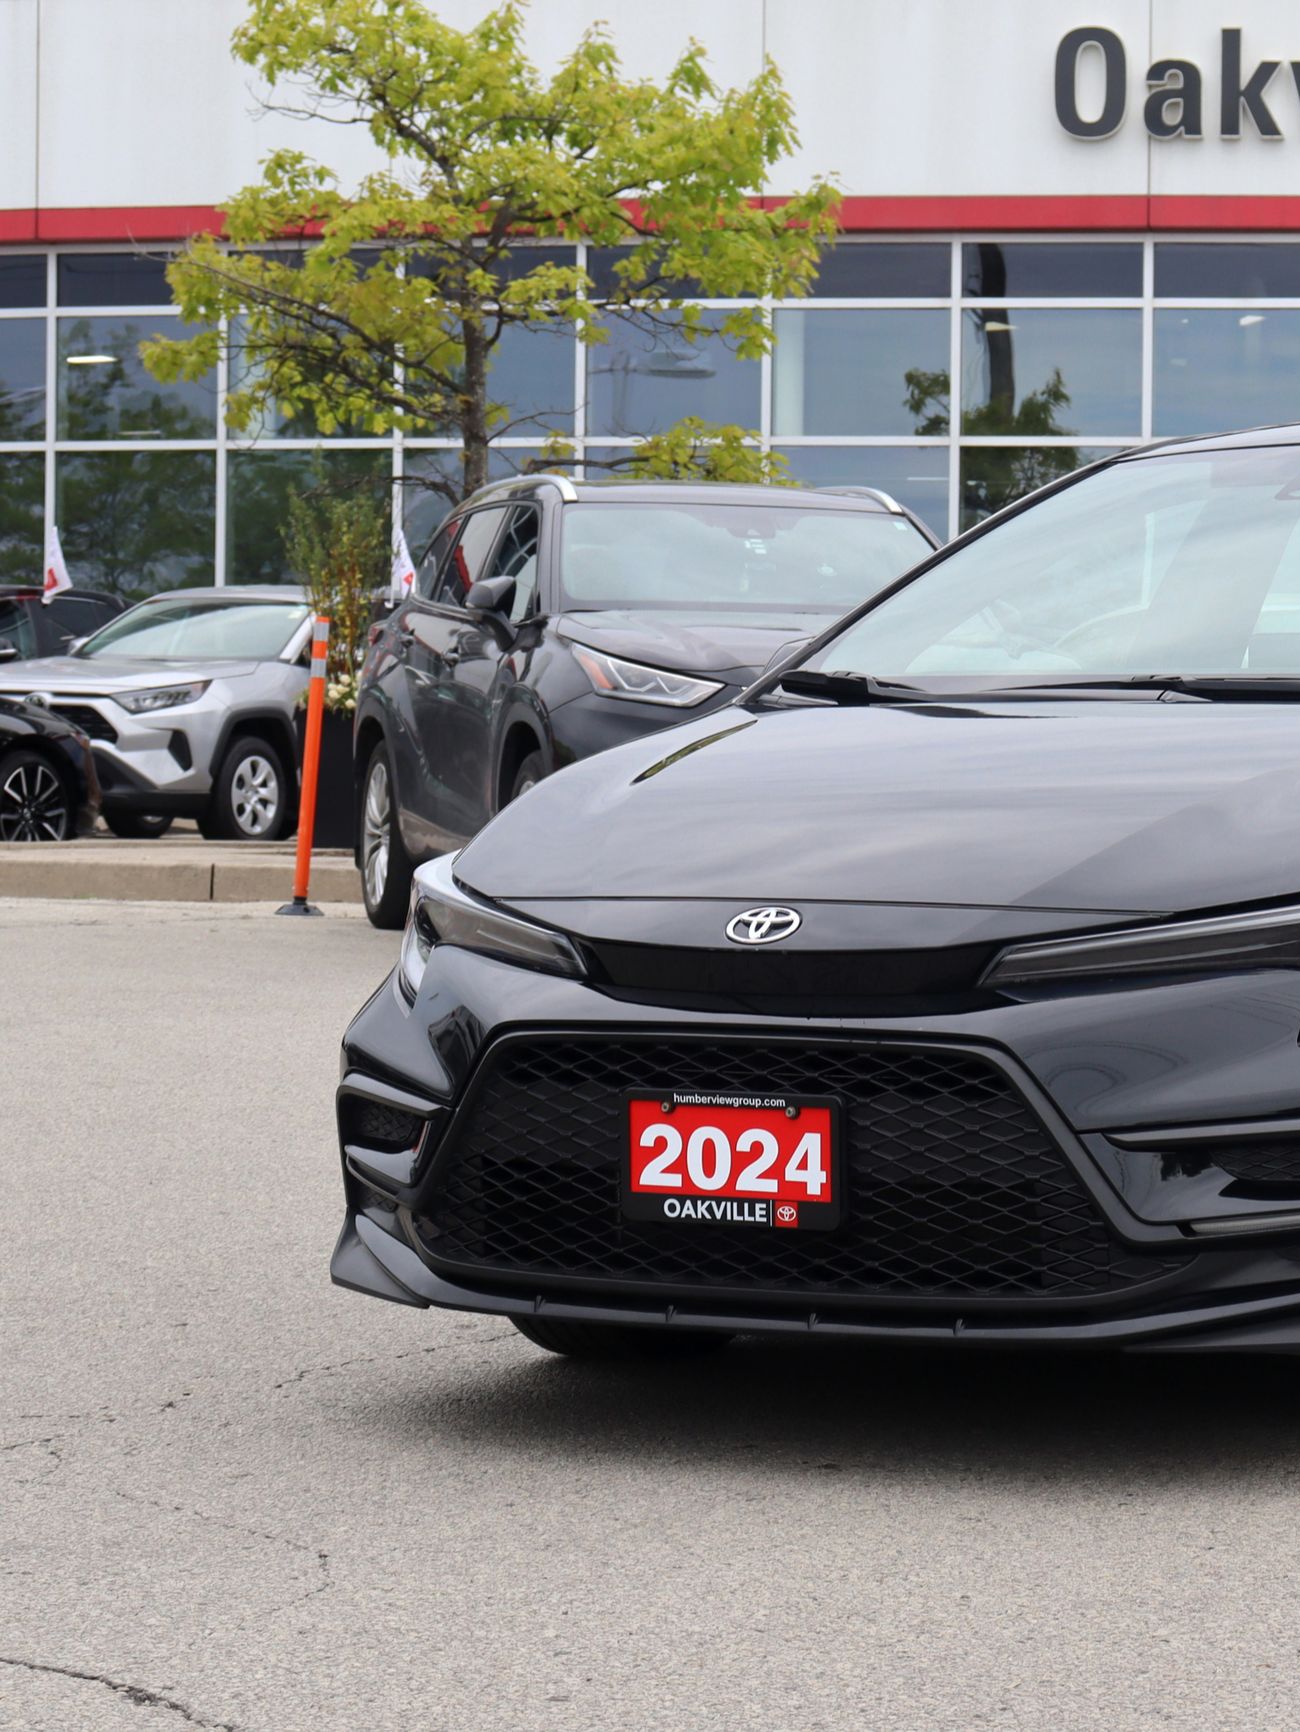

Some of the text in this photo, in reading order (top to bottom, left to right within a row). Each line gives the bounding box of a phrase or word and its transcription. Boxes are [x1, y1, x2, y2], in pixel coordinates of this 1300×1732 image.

[673, 1093, 786, 1108] humberviewgroup.com
[639, 1123, 827, 1196] 2024
[663, 1198, 768, 1223] OAKVILLE
